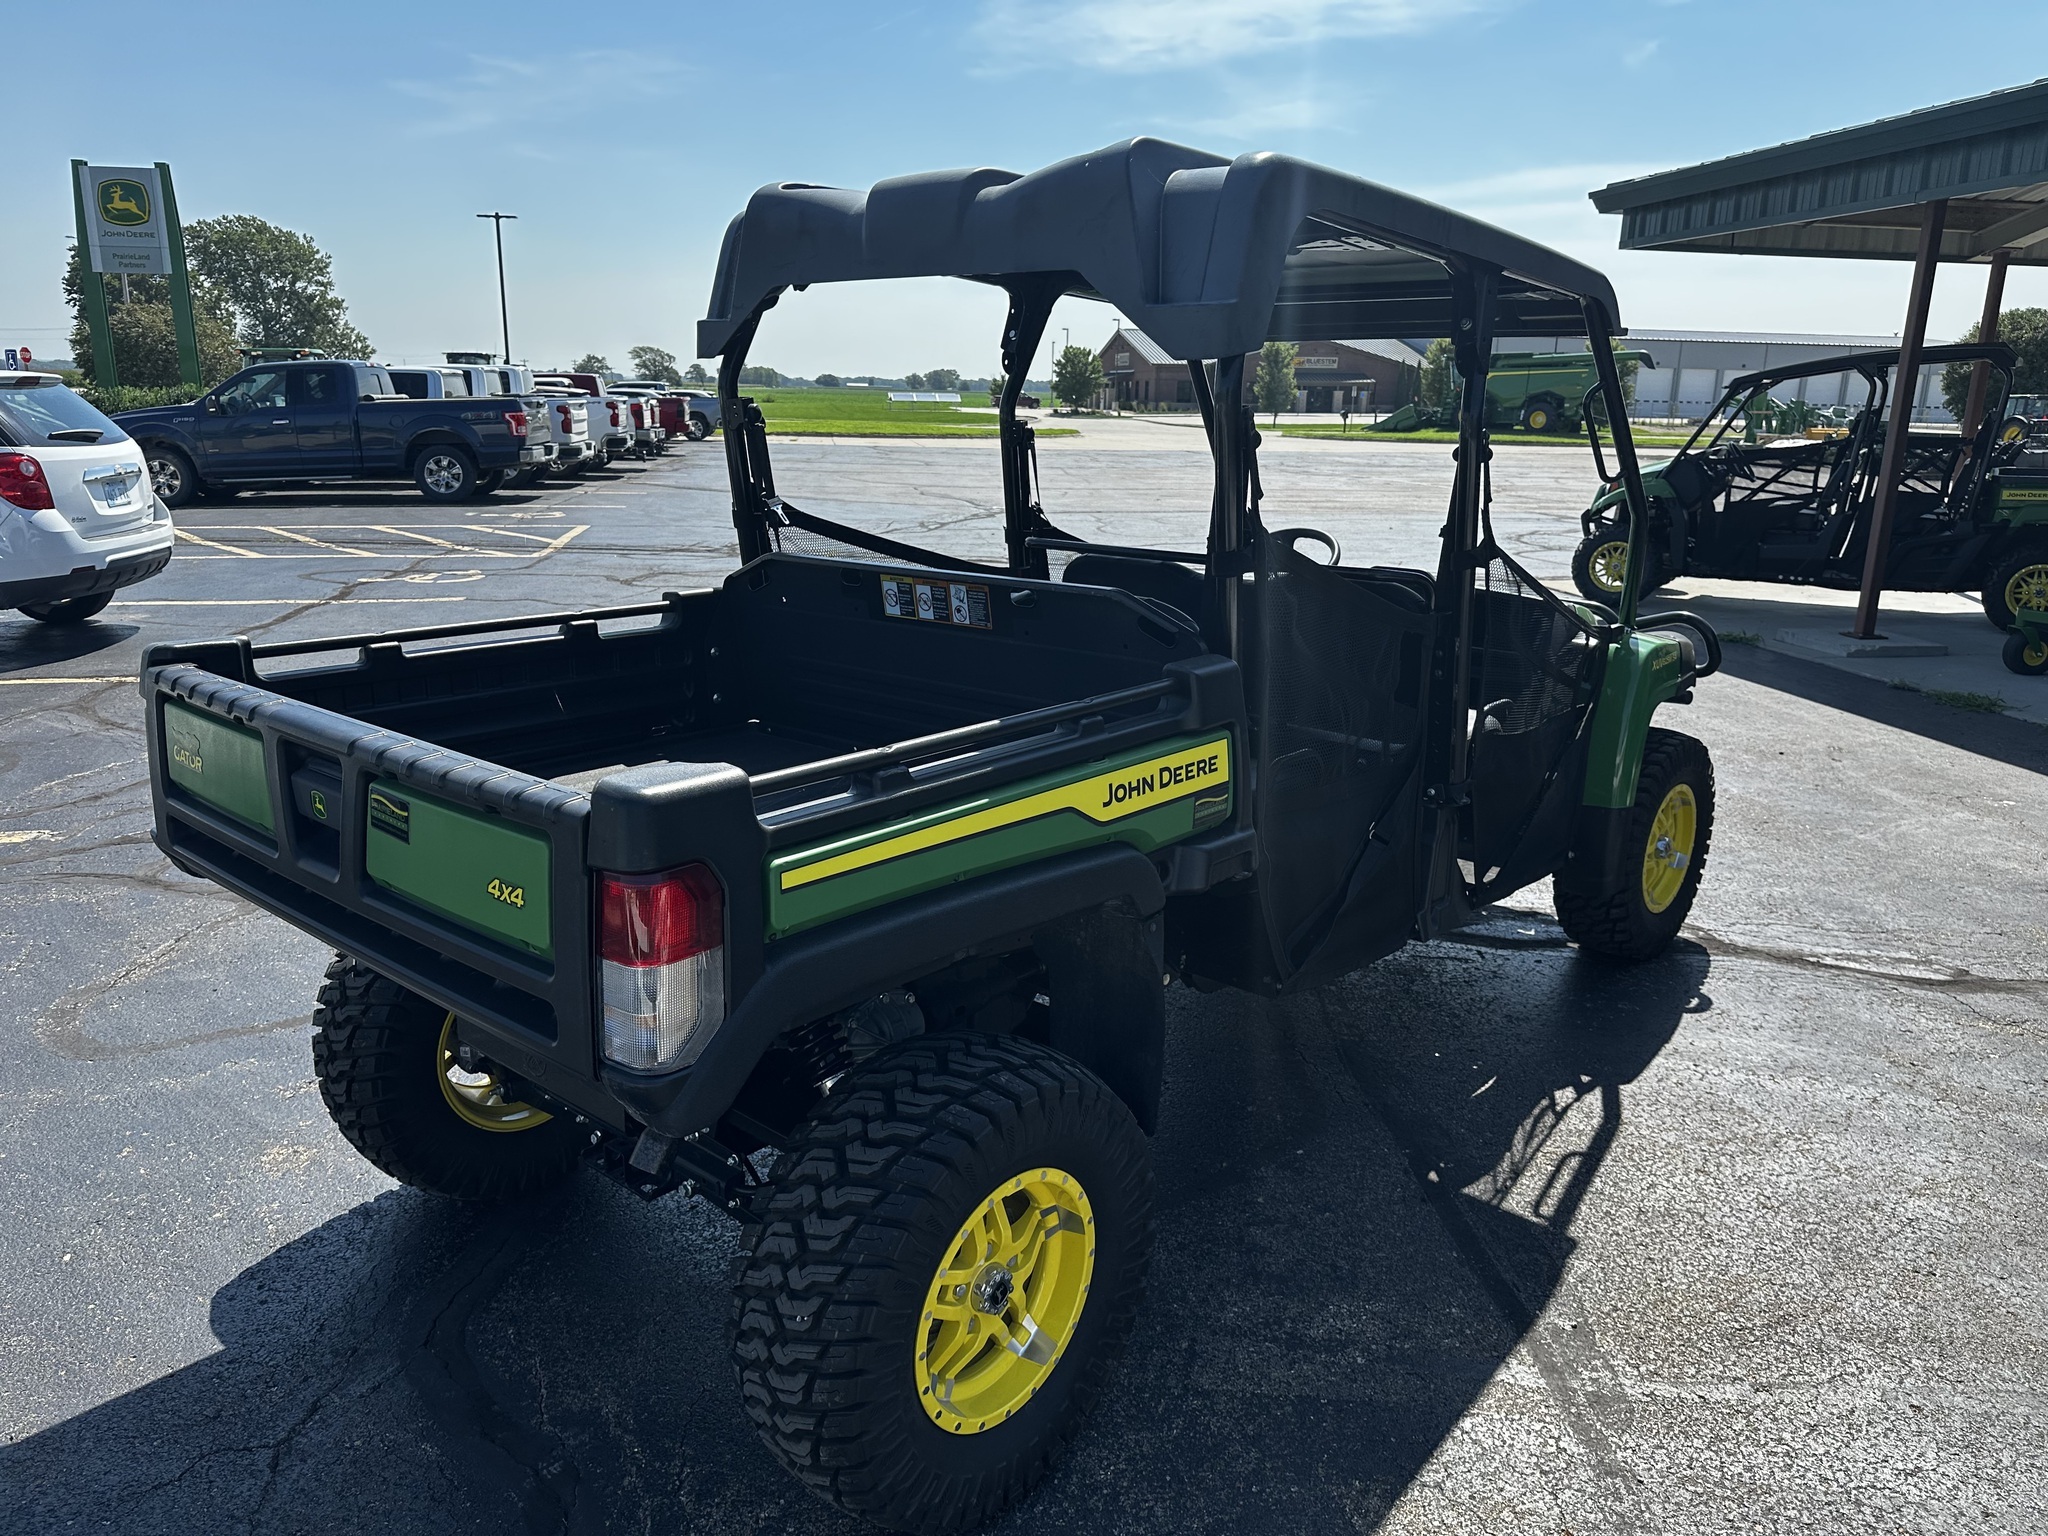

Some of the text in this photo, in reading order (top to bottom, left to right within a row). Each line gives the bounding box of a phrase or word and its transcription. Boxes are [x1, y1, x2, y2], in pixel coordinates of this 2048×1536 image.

[126, 230, 156, 238] DEERE
[173, 745, 203, 772] GATOR
[1102, 754, 1219, 808] JOHN DEERE
